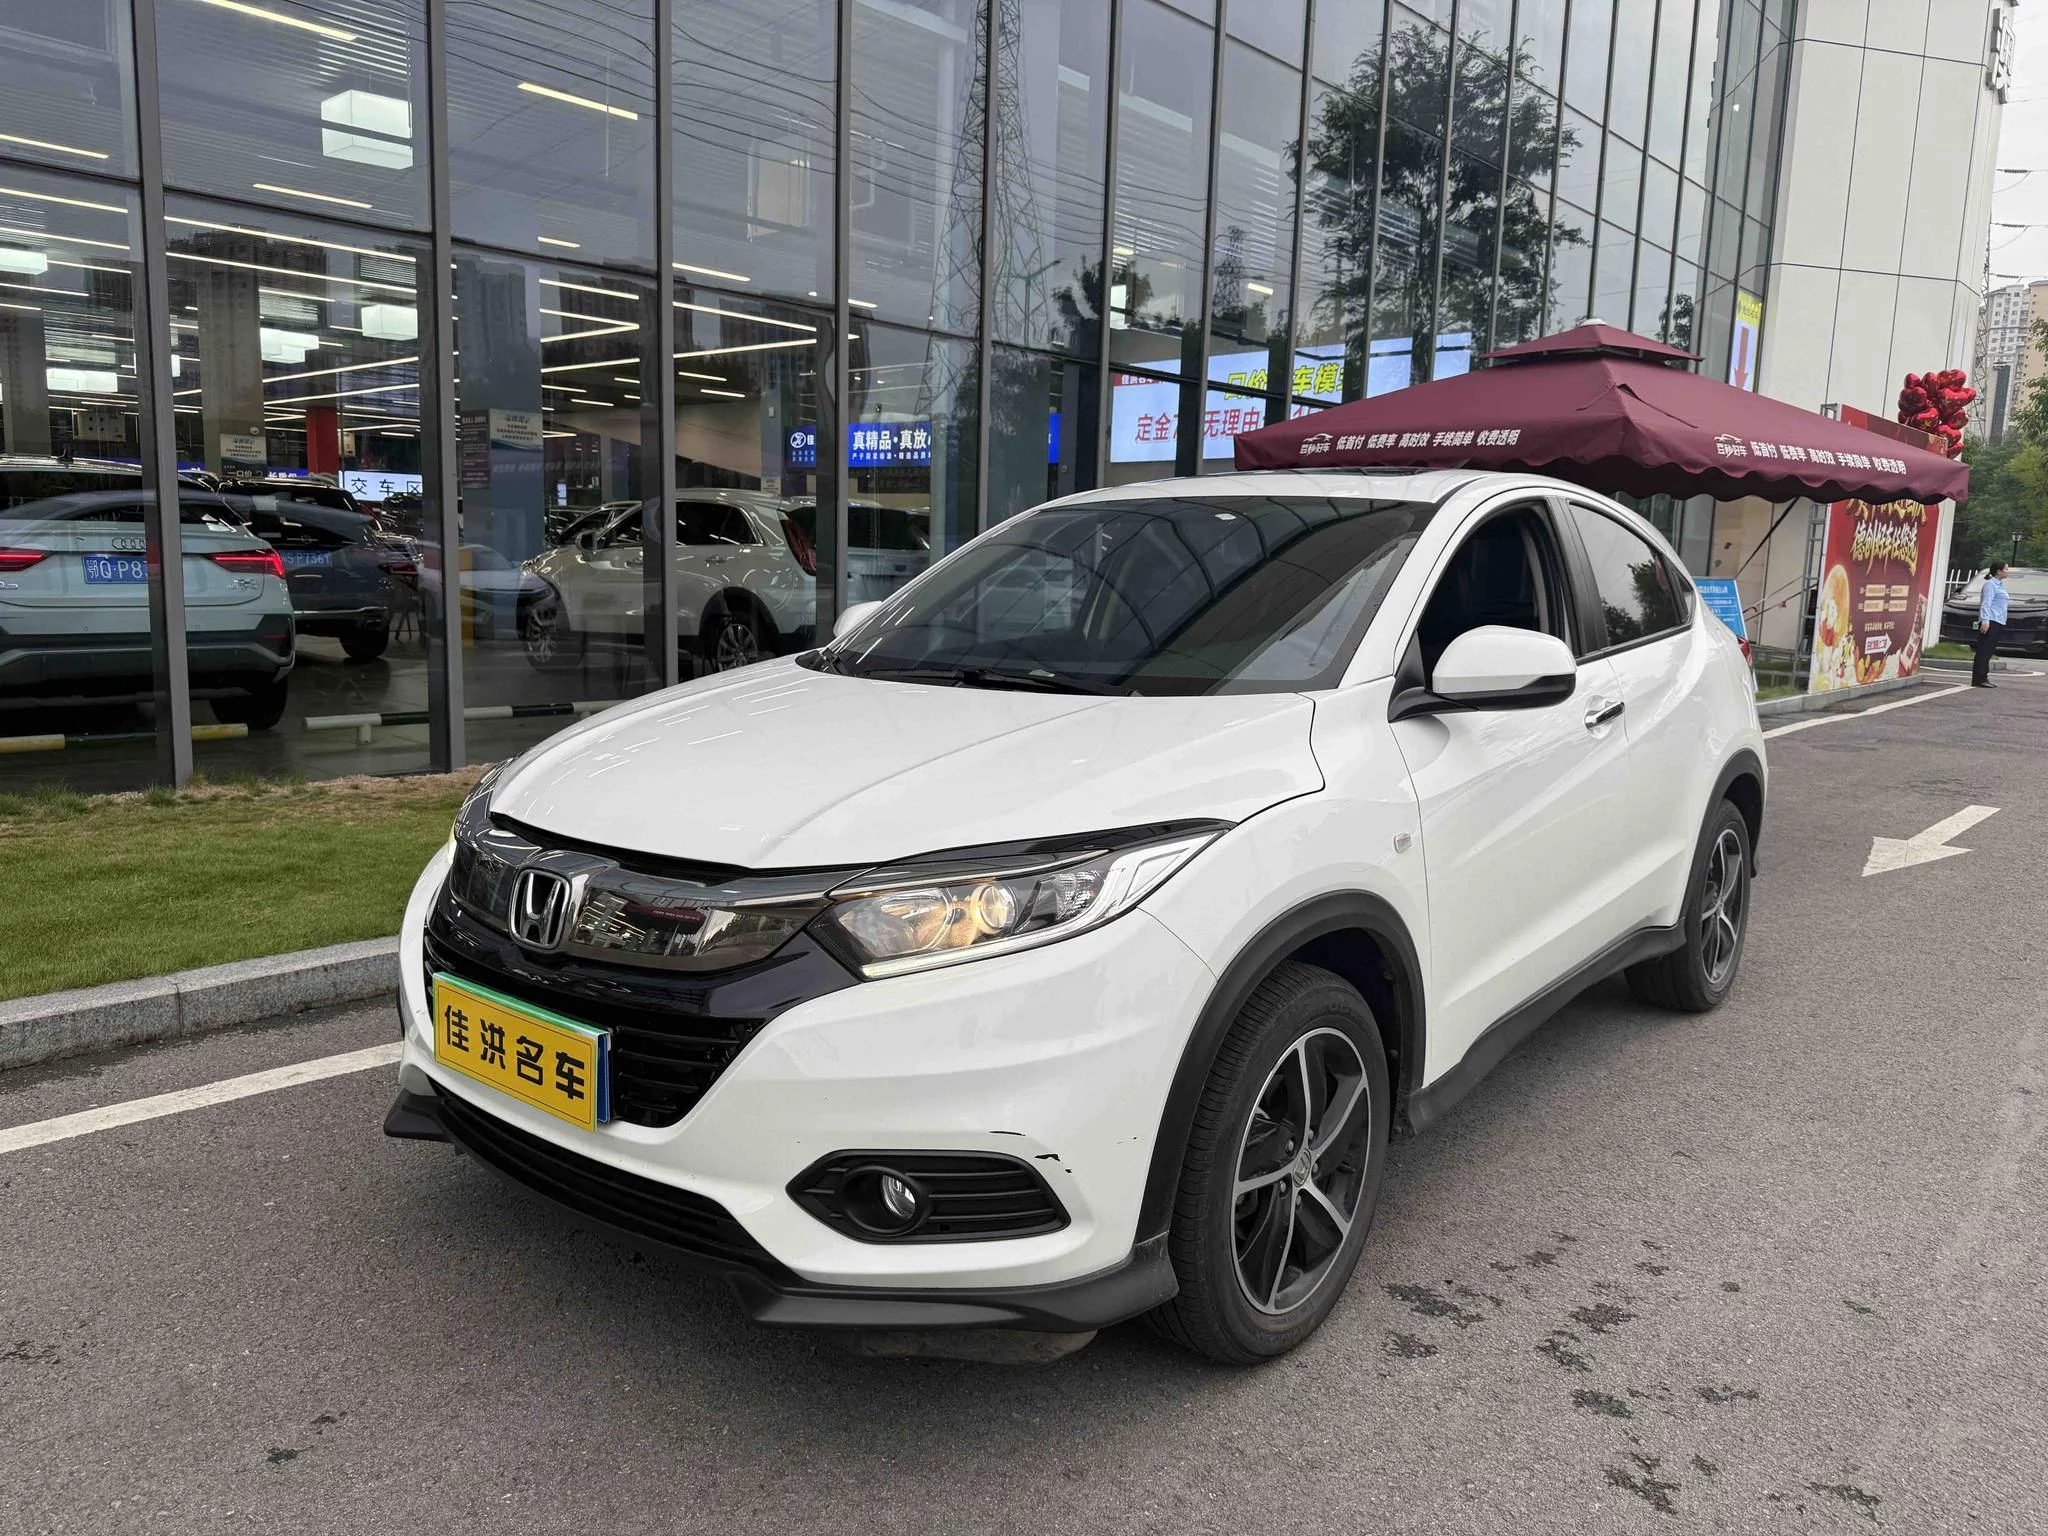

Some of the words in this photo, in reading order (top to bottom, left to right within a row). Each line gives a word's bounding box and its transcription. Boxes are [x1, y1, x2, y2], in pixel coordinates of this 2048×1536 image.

[853, 429, 931, 450] 真精品·真放
[1336, 434, 1366, 450] 低首付
[1399, 431, 1431, 448] 高时效
[1432, 431, 1473, 447] 手续简单
[1476, 429, 1521, 446] 收费透明
[1750, 440, 1778, 459] 低首付
[1837, 452, 1872, 470] 手续简单
[1872, 456, 1907, 475] 收费透明
[351, 477, 422, 496] 交车区
[444, 1005, 585, 1100] 佳洪名车
